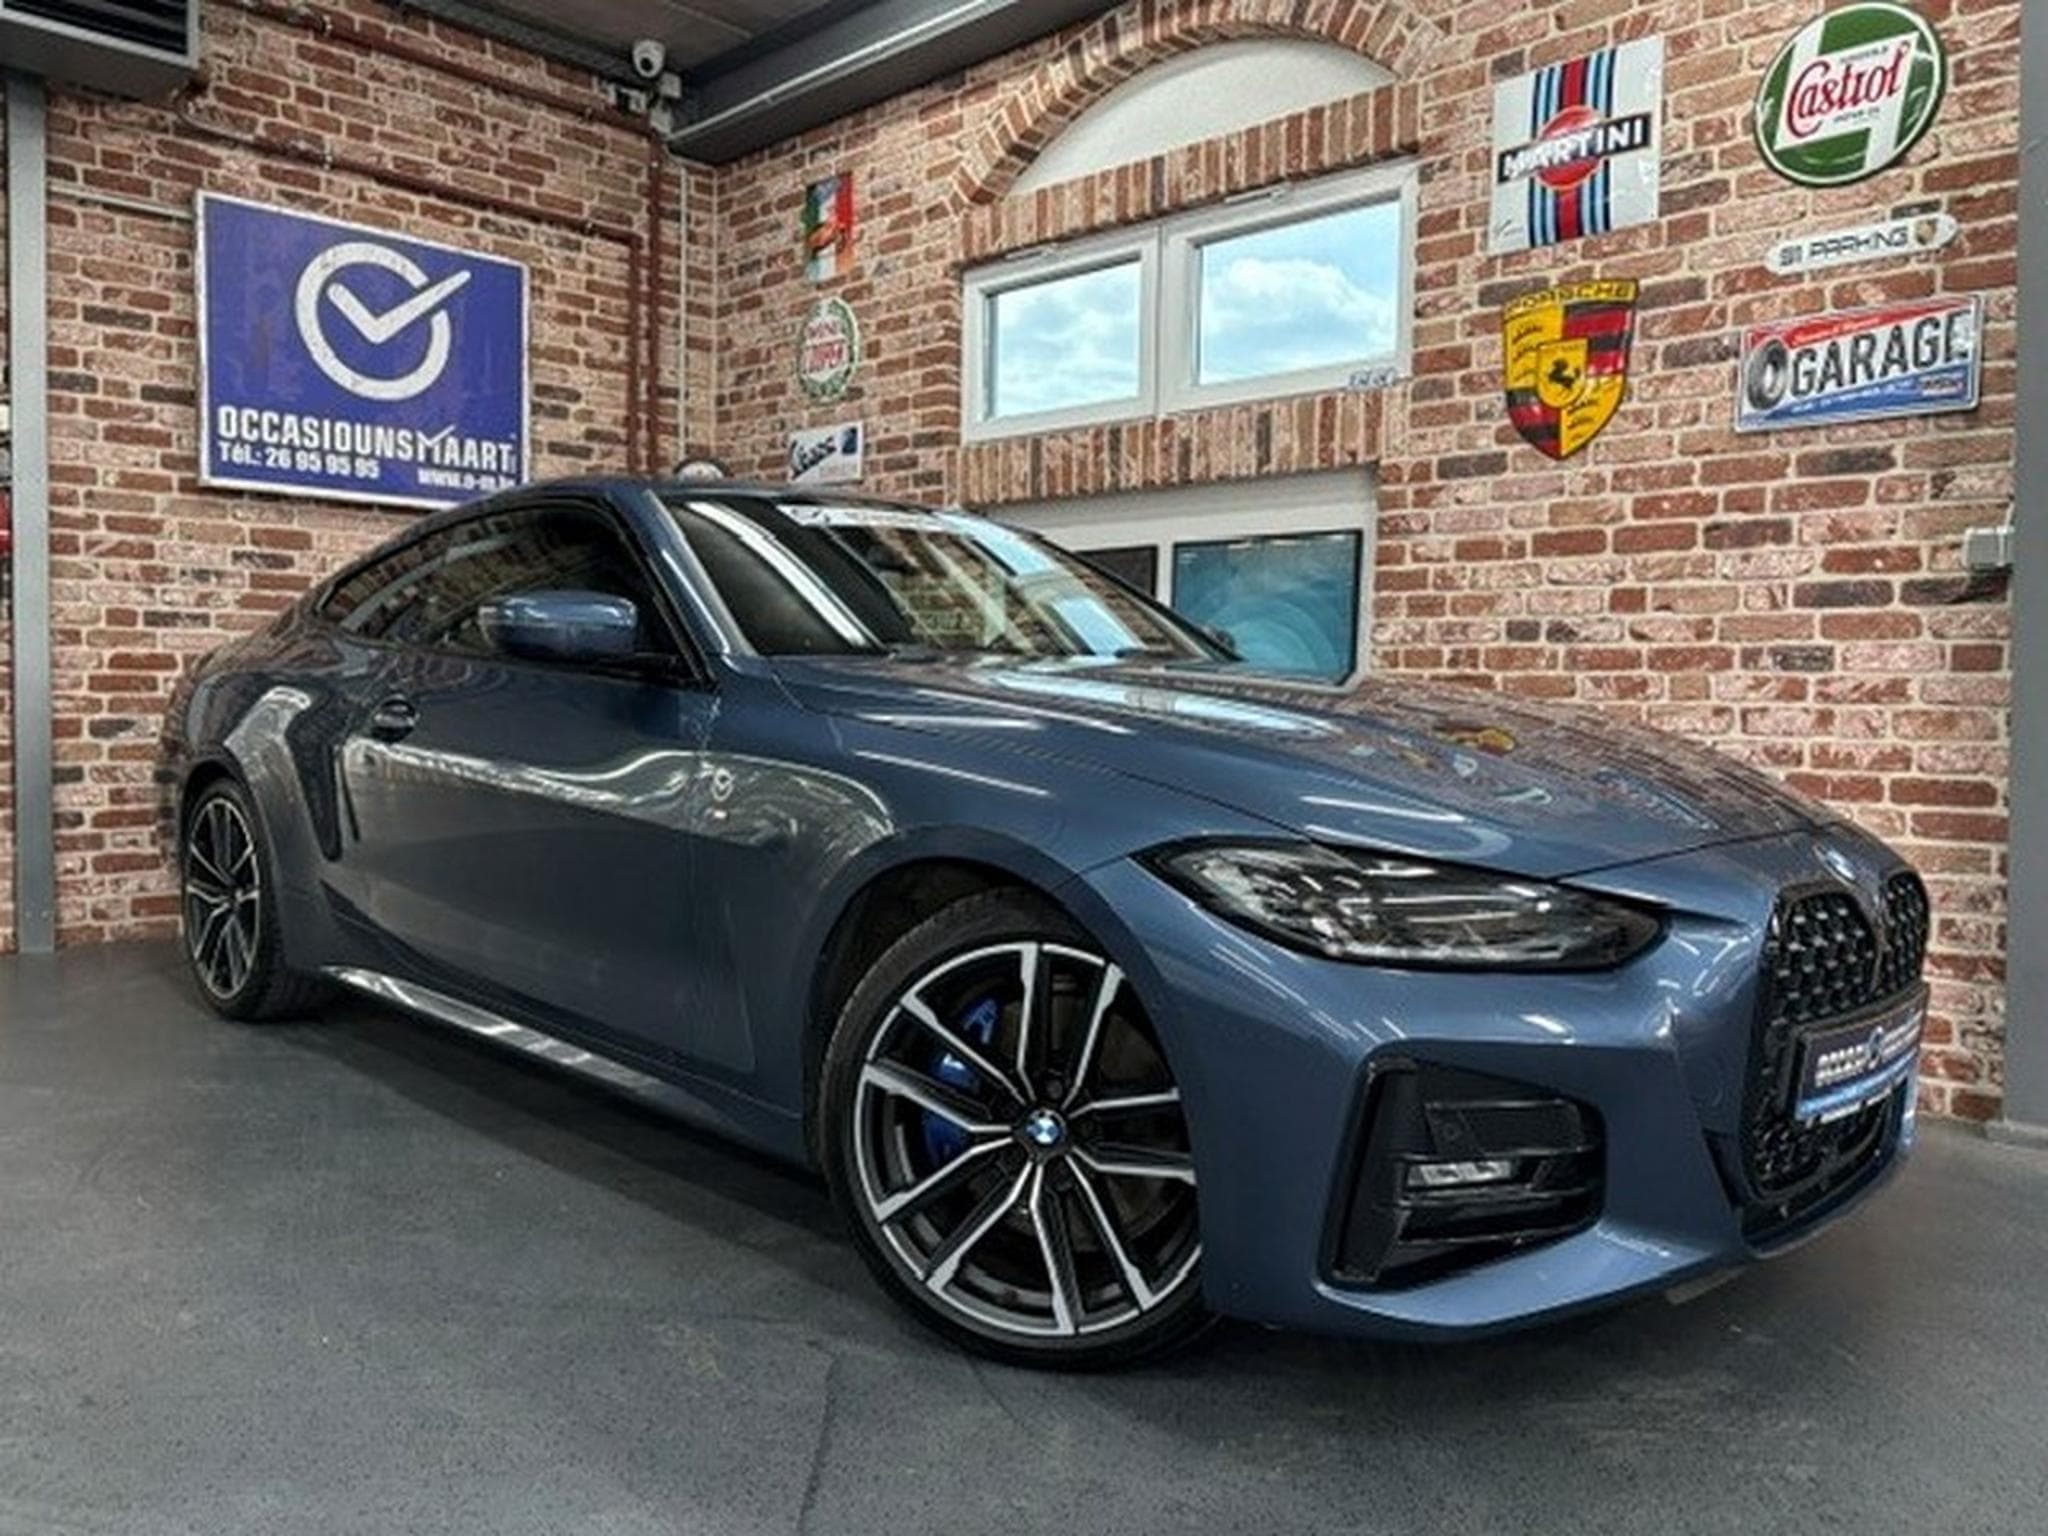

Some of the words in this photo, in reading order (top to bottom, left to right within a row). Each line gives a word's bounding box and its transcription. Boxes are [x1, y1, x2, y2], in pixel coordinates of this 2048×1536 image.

[1787, 41, 1911, 138] Castrol
[1503, 117, 1643, 179] MARTINI
[1790, 309, 1972, 398] GARAGE
[265, 447, 292, 470] 26
